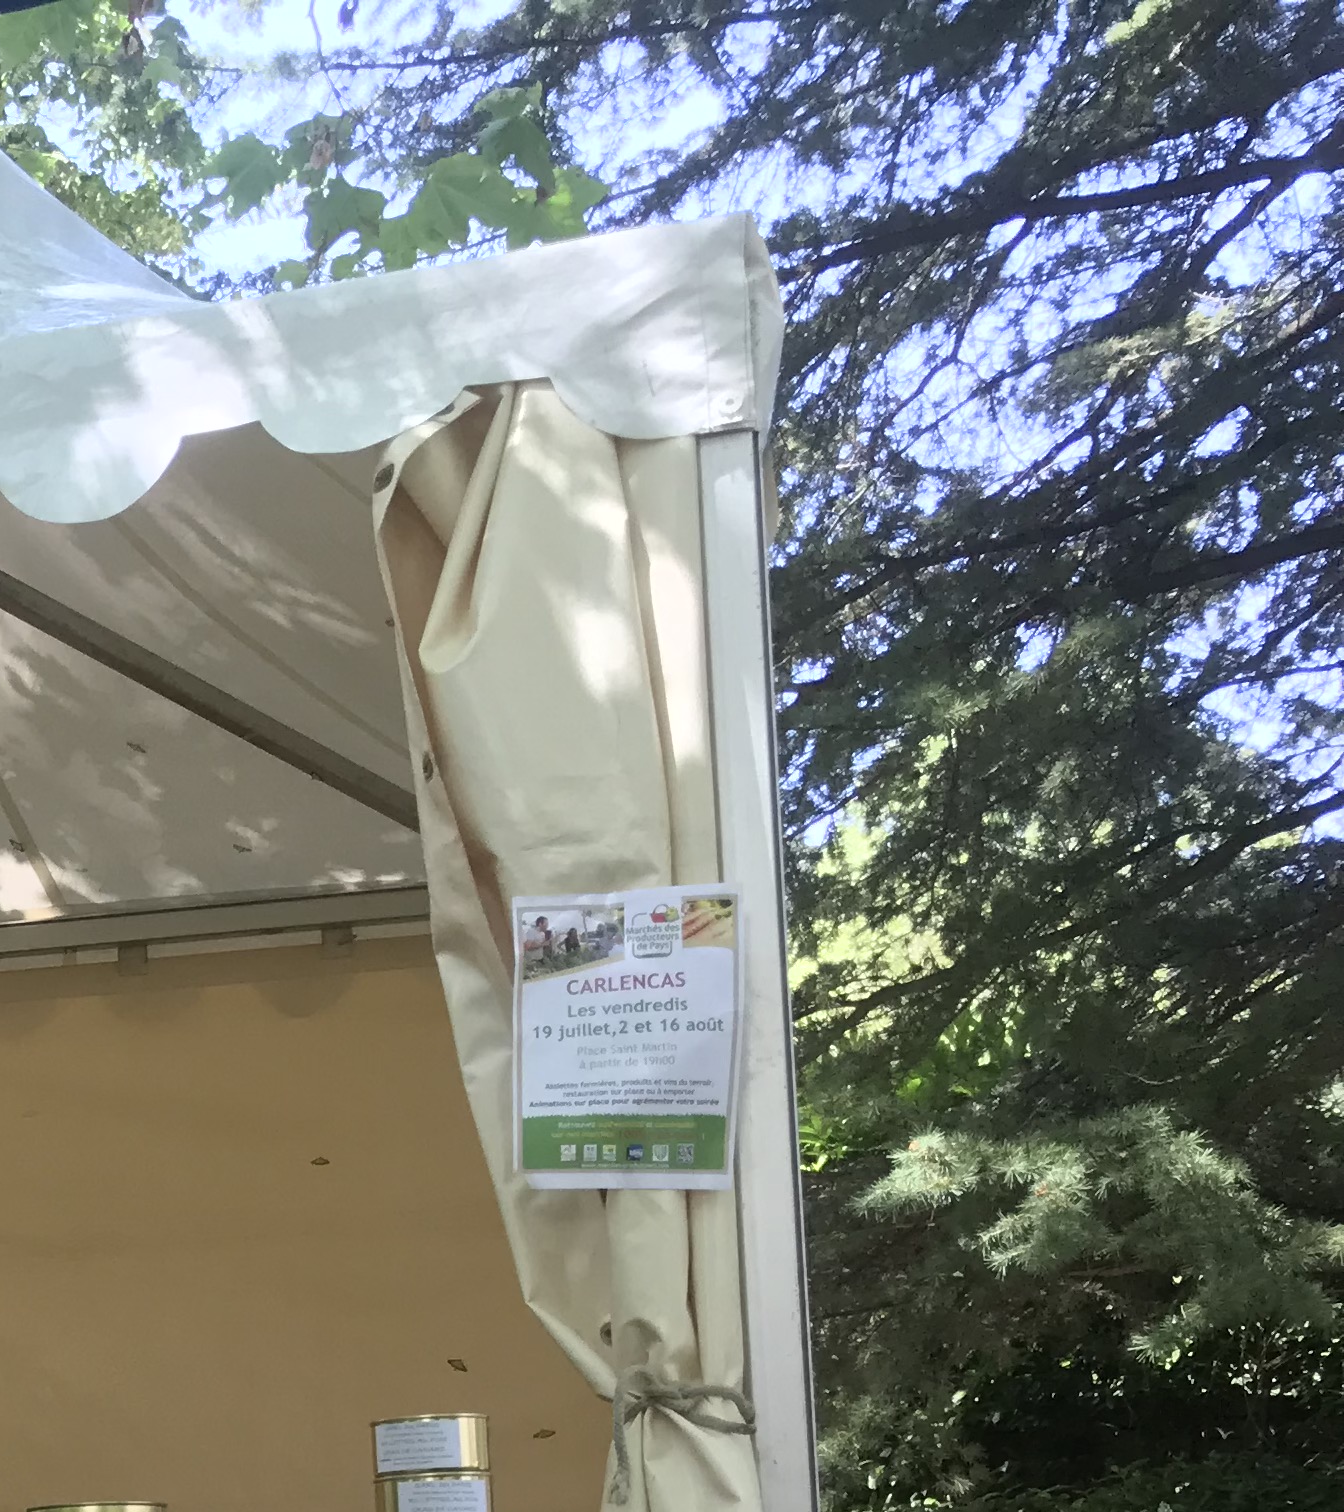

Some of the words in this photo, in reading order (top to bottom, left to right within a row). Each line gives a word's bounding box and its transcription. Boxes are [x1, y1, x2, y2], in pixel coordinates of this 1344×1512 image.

[566, 971, 687, 996] CARLENCAS
[567, 1004, 597, 1018] Les
[602, 997, 688, 1014] vendredis
[532, 1025, 553, 1039] 19
[634, 1020, 653, 1034] et
[660, 1018, 679, 1032] 16
[686, 1016, 725, 1032] août
[625, 1057, 640, 1068] de
